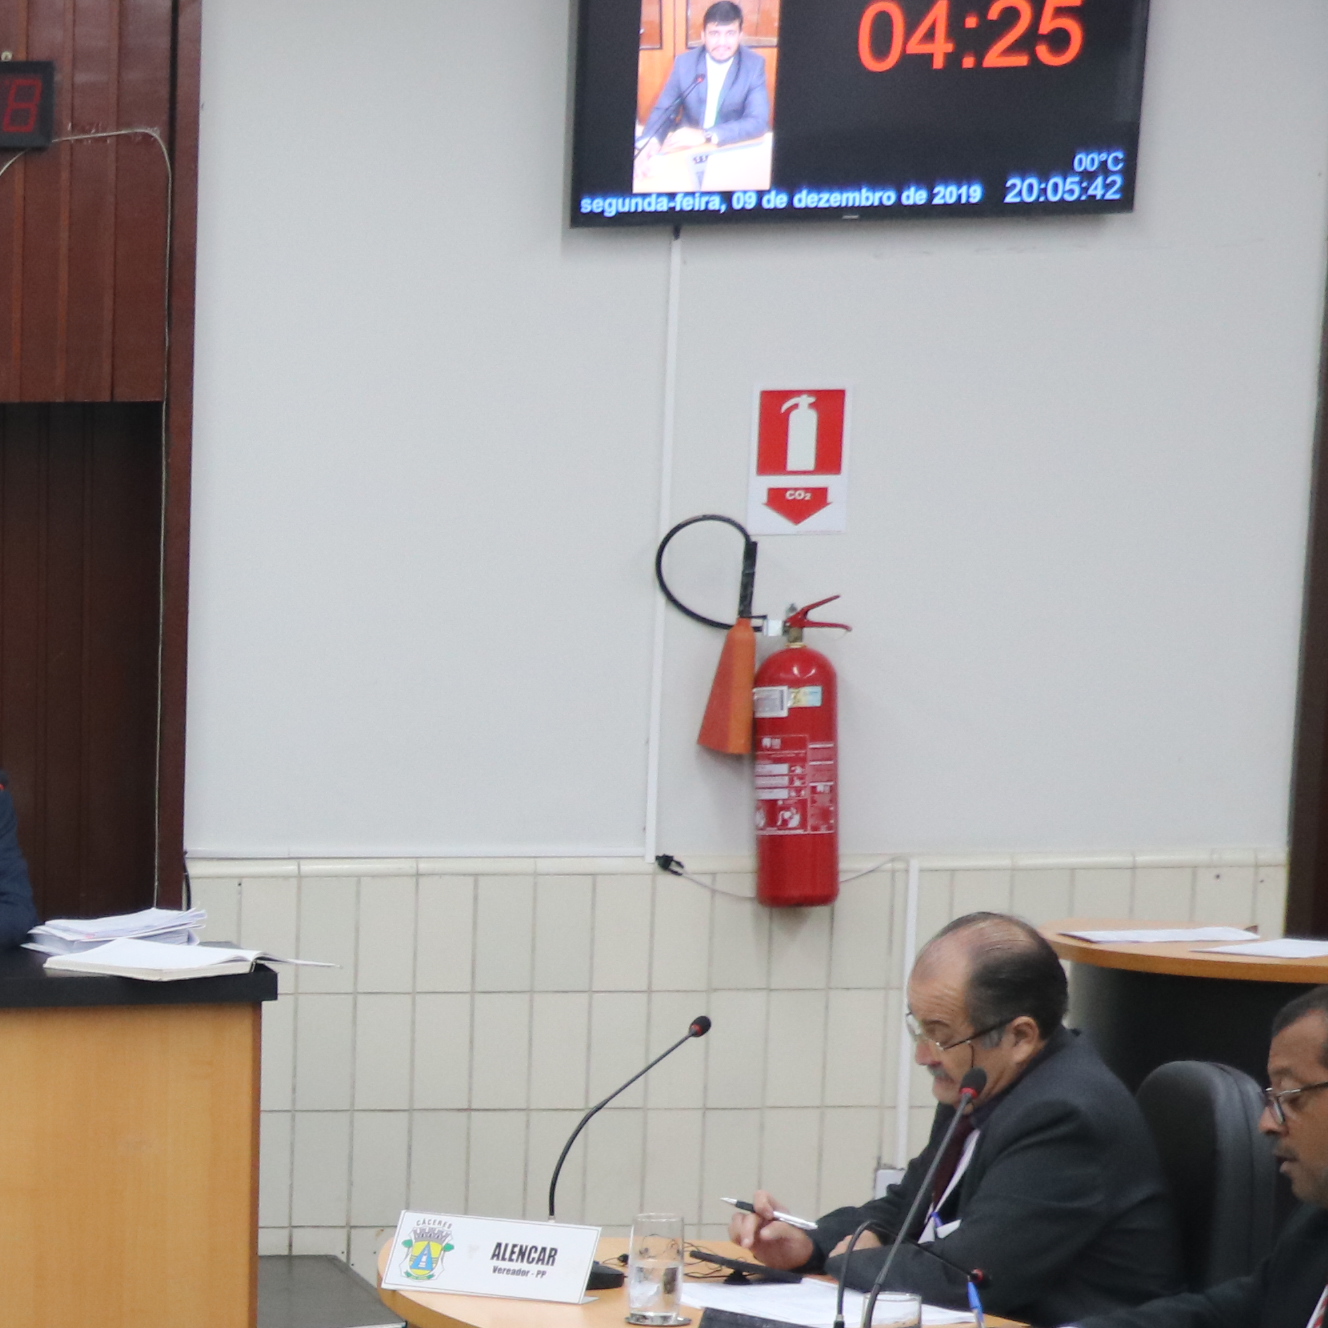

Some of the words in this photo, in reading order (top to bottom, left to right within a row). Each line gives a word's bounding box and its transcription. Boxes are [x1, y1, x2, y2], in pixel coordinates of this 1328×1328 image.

[858, 0, 1084, 72] 04:25
[1073, 151, 1124, 172] 00°C
[580, 192, 727, 217] segunda-feira,
[732, 190, 757, 210] 09
[761, 189, 787, 209] de
[793, 185, 896, 208] dezembro
[901, 186, 928, 206] de
[931, 183, 984, 205] 2019
[1004, 173, 1124, 203] 20:05:42
[490, 1241, 558, 1267] ALENCAR
[492, 1265, 531, 1278] Vereador
